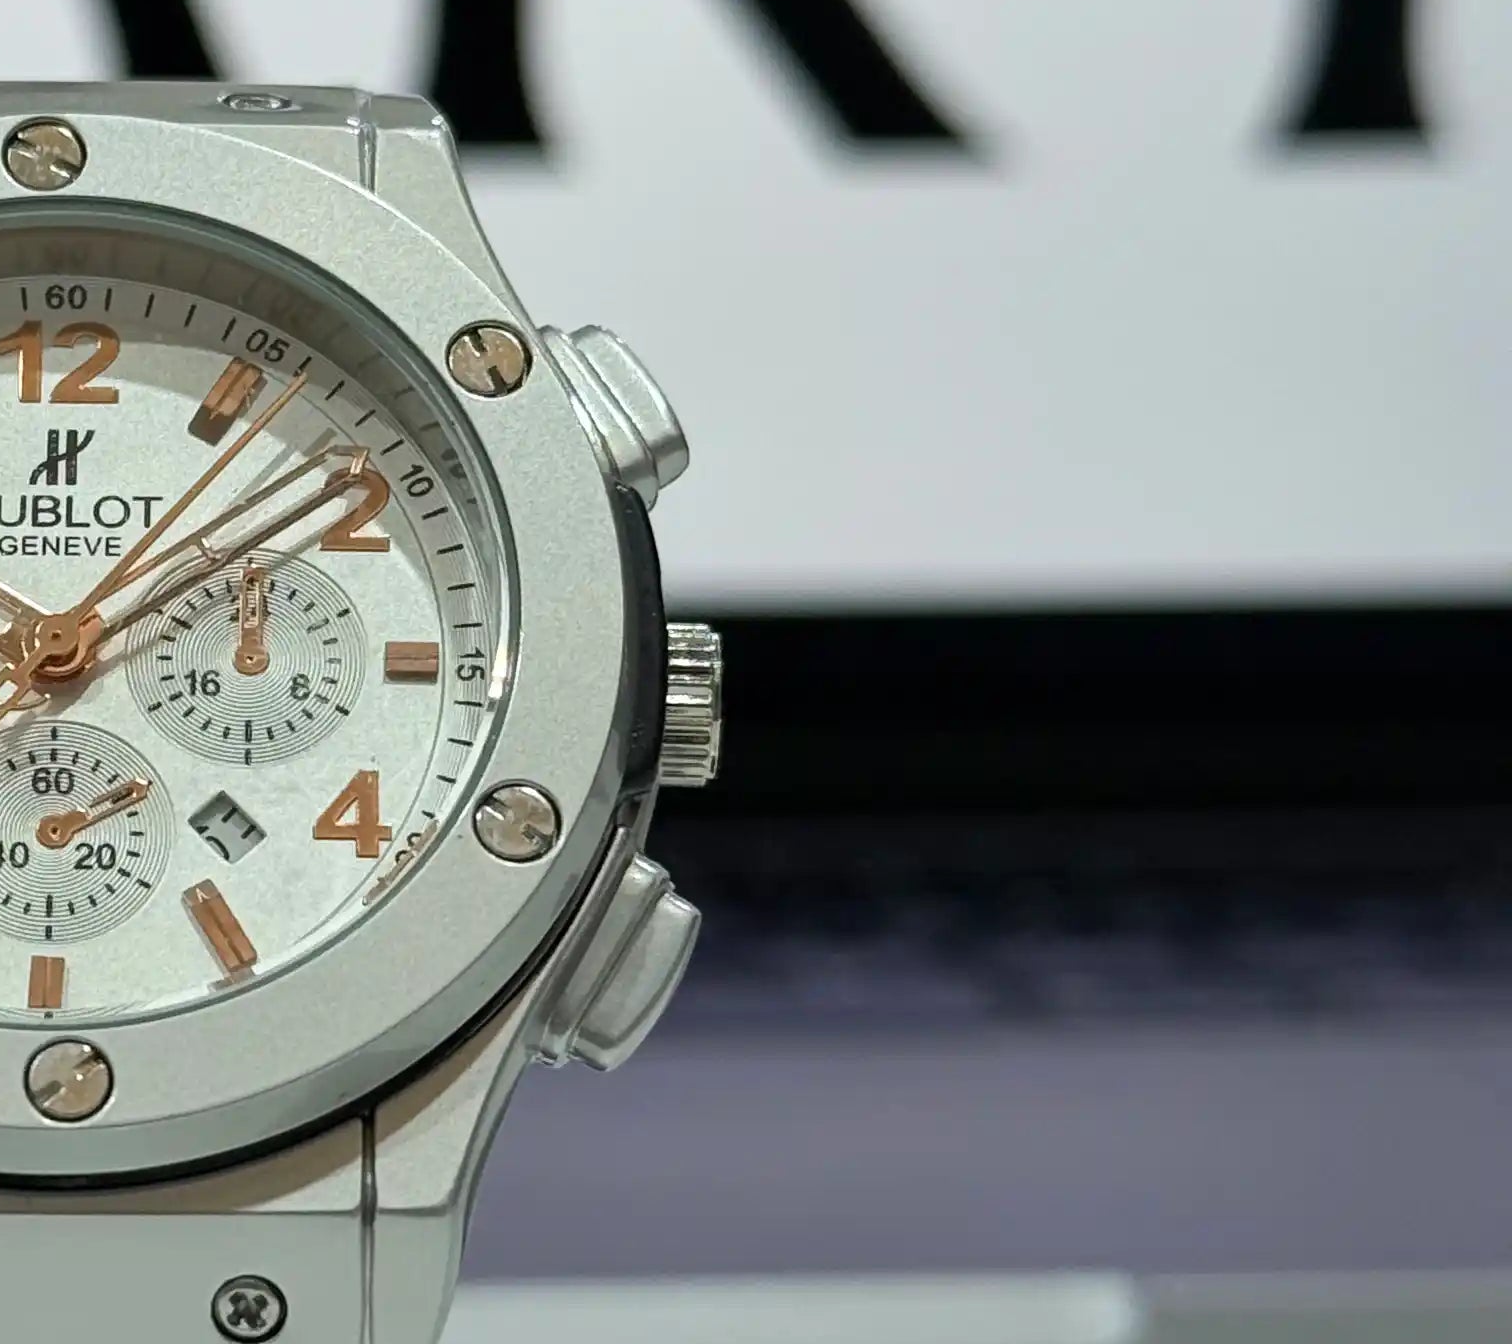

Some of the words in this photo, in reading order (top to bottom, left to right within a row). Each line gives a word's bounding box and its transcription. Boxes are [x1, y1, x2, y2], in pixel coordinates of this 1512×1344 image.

[45, 284, 87, 309] 60
[245, 328, 291, 363] 05
[399, 464, 434, 497] 10
[320, 466, 391, 552] 2
[456, 647, 486, 682] 15
[184, 668, 221, 697] 16
[290, 672, 311, 701] 8
[31, 767, 76, 795] 60
[313, 769, 393, 858] 4
[74, 842, 117, 870] 20
